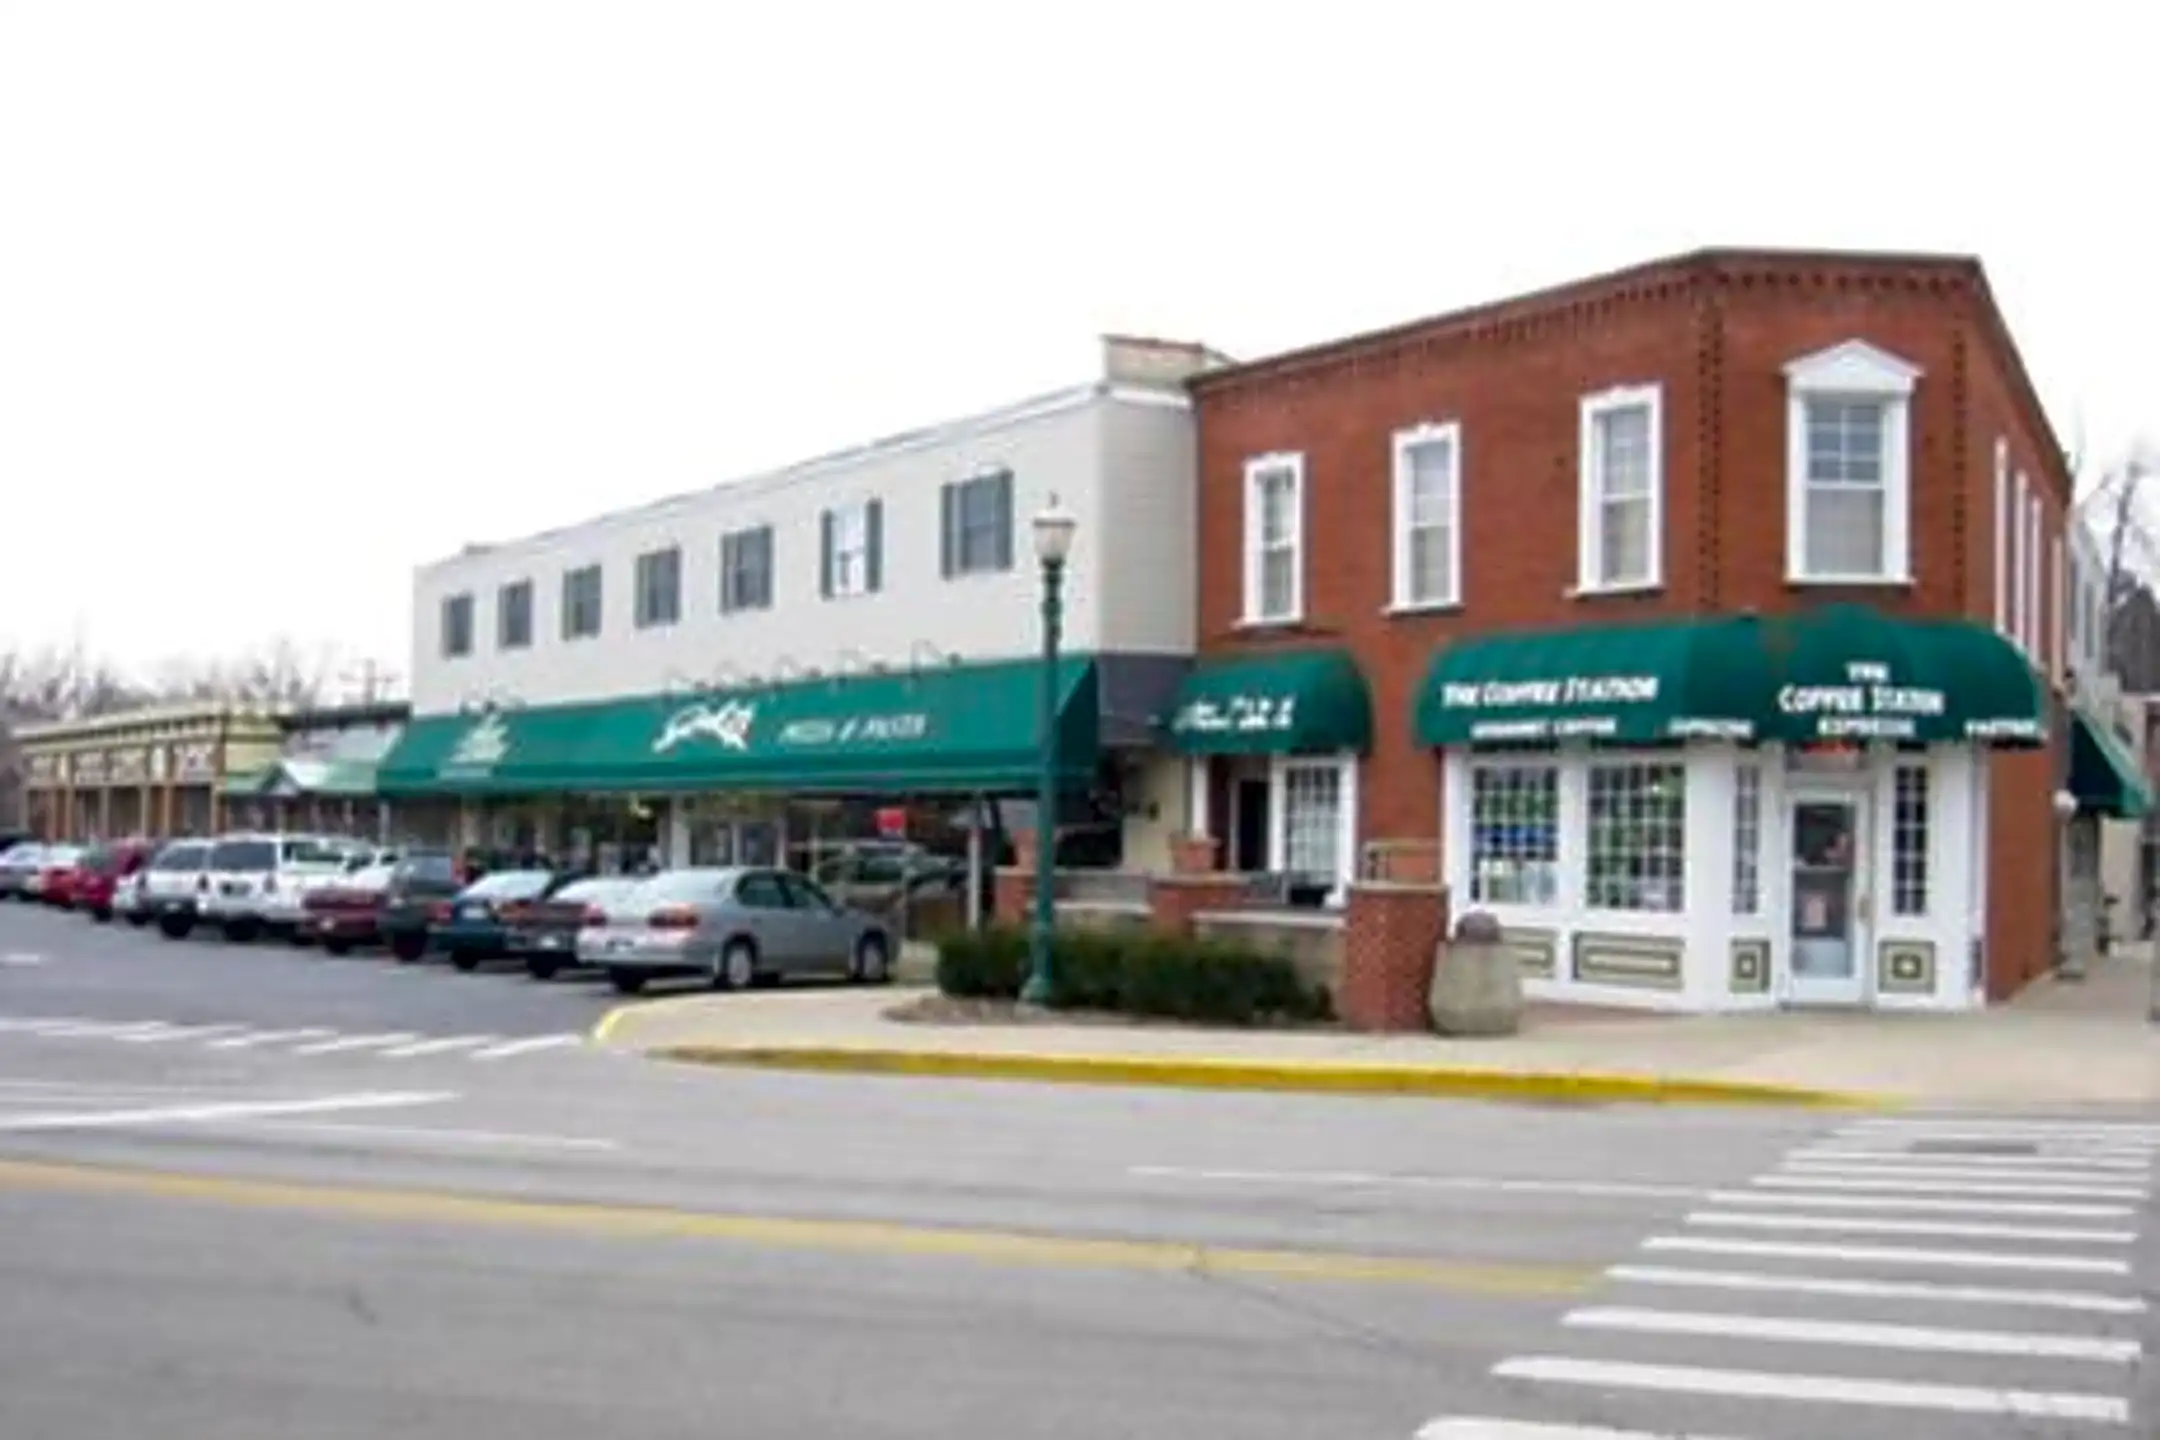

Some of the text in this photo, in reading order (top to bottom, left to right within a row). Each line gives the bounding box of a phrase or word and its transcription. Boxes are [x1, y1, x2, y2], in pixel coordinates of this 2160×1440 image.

[1442, 675, 1659, 706] THE COFFEE STATION
[1778, 684, 1944, 714] COFFEE STATION
